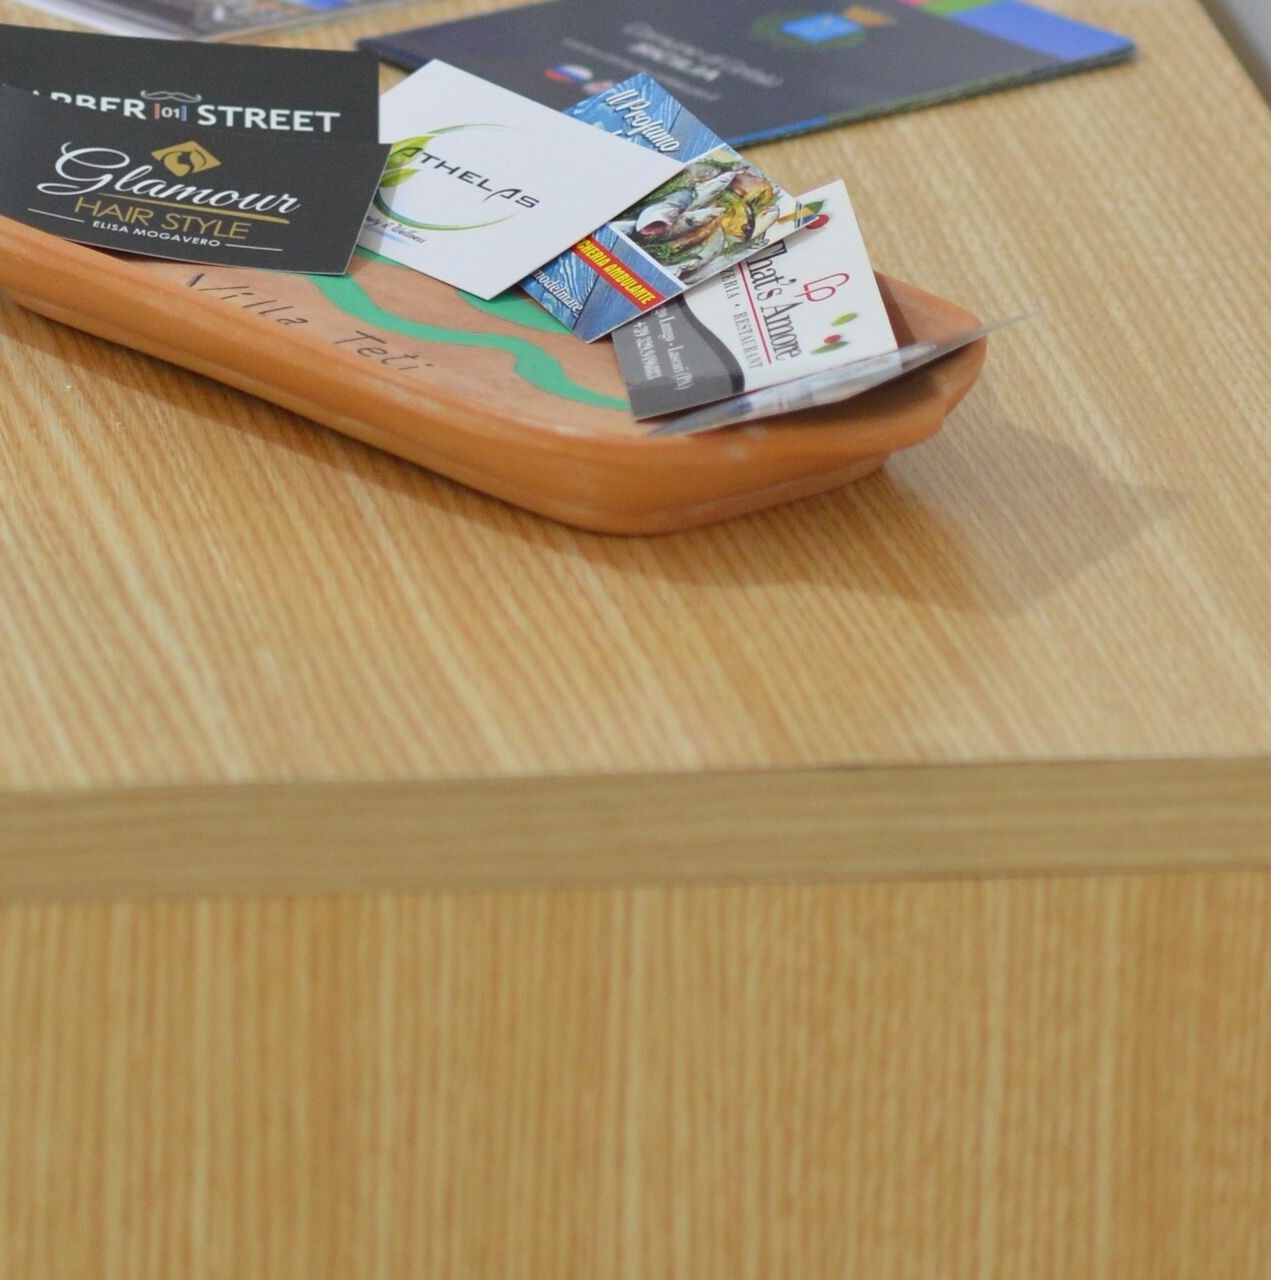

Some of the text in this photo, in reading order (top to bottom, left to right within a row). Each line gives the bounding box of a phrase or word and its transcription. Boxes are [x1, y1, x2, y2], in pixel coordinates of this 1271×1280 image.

[196, 104, 341, 133] STREET
[615, 97, 681, 152] Profumo
[36, 141, 301, 214] Glamour
[390, 146, 540, 209] ATHELAS
[73, 196, 252, 240] HAIR STYLE
[92, 220, 221, 248] ELISA MOGAVERO
[602, 263, 657, 306] AMBULANTE
[746, 239, 804, 361] That's Amore
[188, 273, 434, 371] Villa Teti
[733, 311, 764, 369] RESTAURANT
